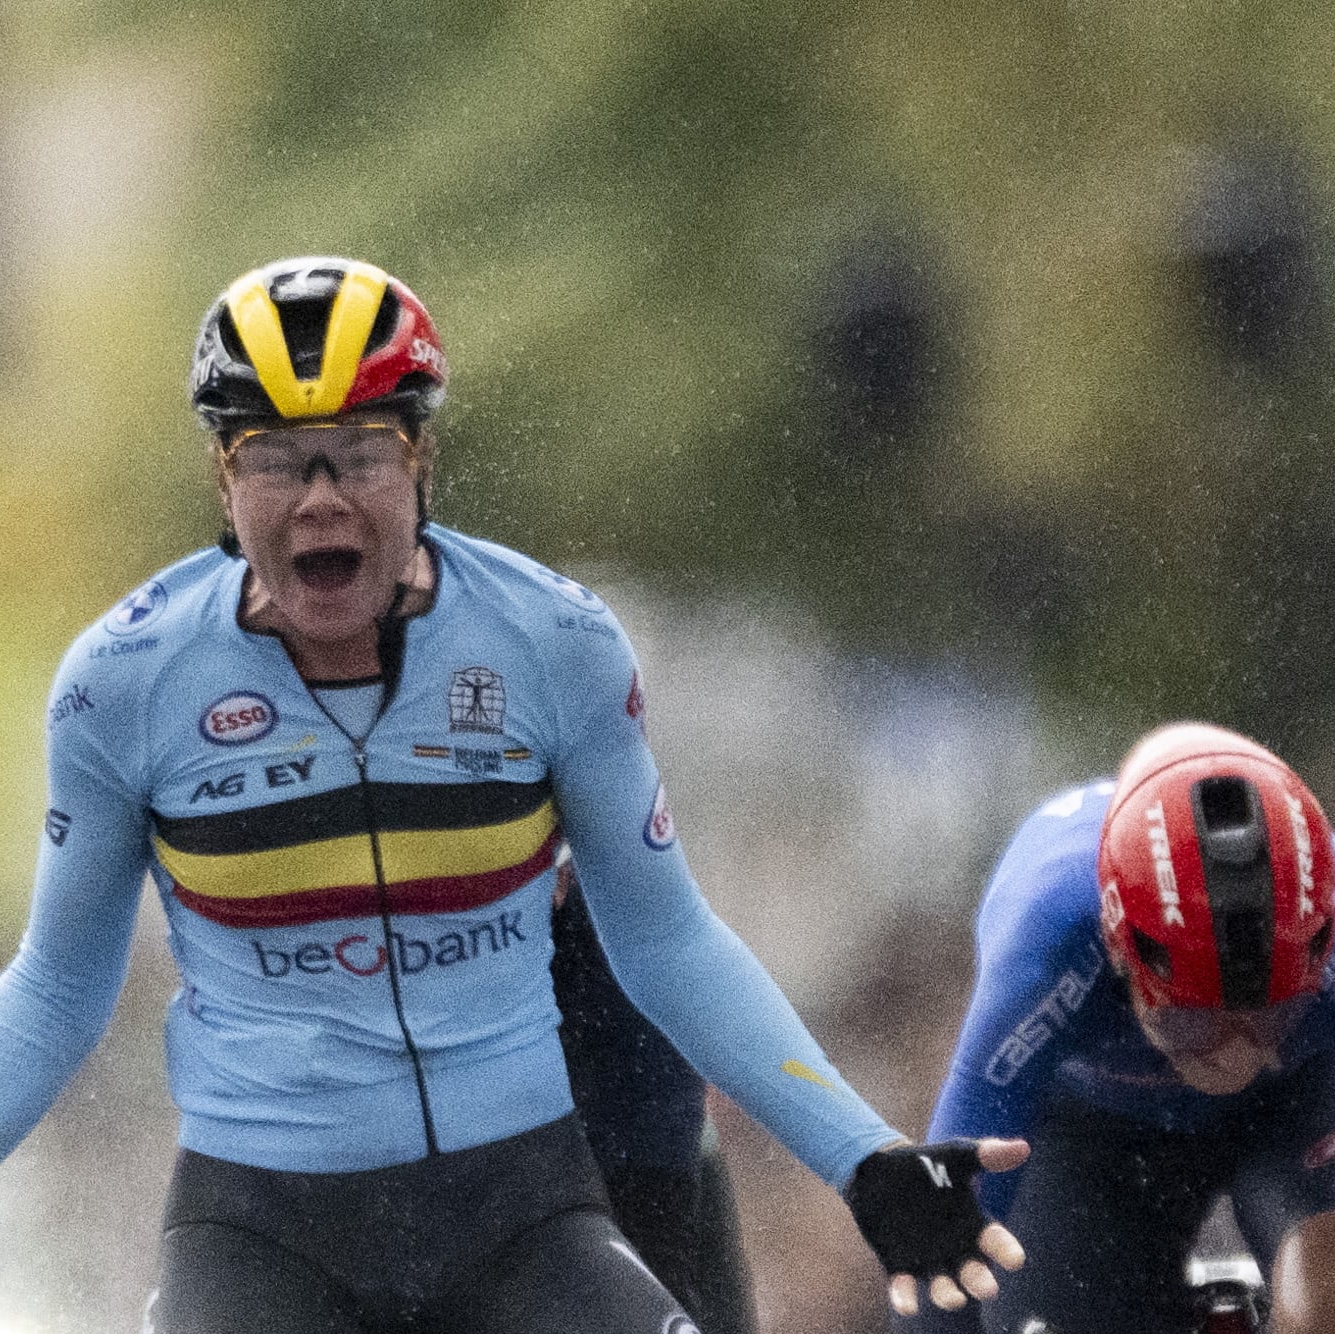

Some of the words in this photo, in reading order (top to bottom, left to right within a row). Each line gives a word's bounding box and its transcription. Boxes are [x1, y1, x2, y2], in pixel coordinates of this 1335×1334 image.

[189, 772, 246, 804] AG
[266, 756, 317, 789] EY
[1146, 799, 1186, 929] TREK
